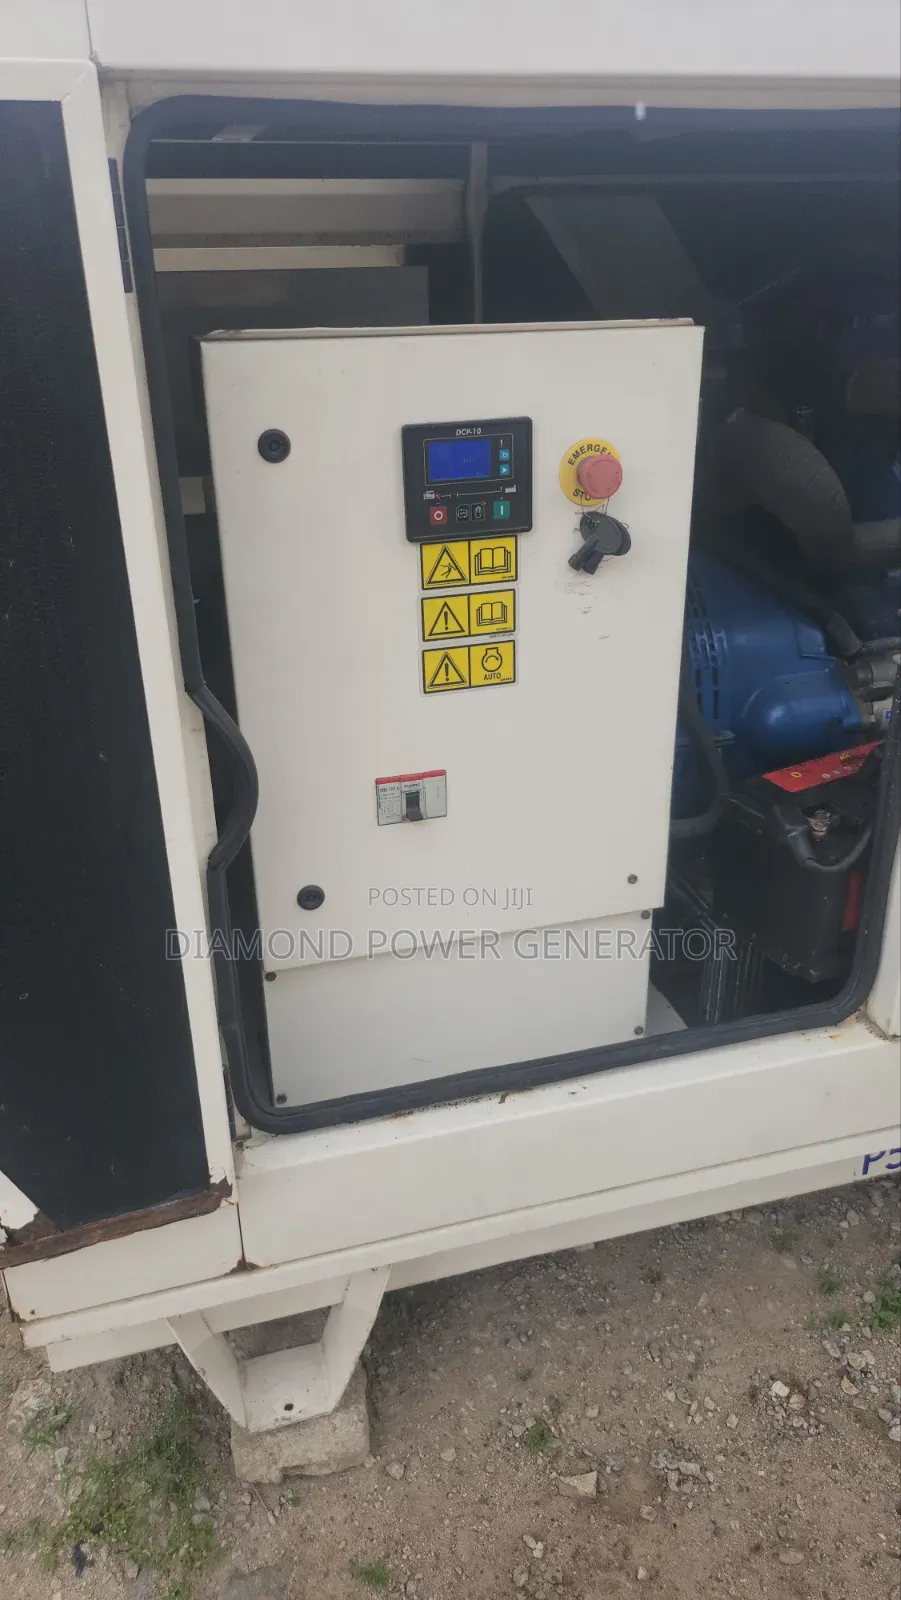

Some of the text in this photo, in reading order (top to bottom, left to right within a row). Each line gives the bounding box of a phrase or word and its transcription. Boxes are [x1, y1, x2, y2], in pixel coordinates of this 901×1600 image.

[456, 427, 482, 436] DCP-10
[567, 443, 611, 466] EMERGE
[573, 488, 596, 501] STO
[483, 672, 501, 681] AUTO
